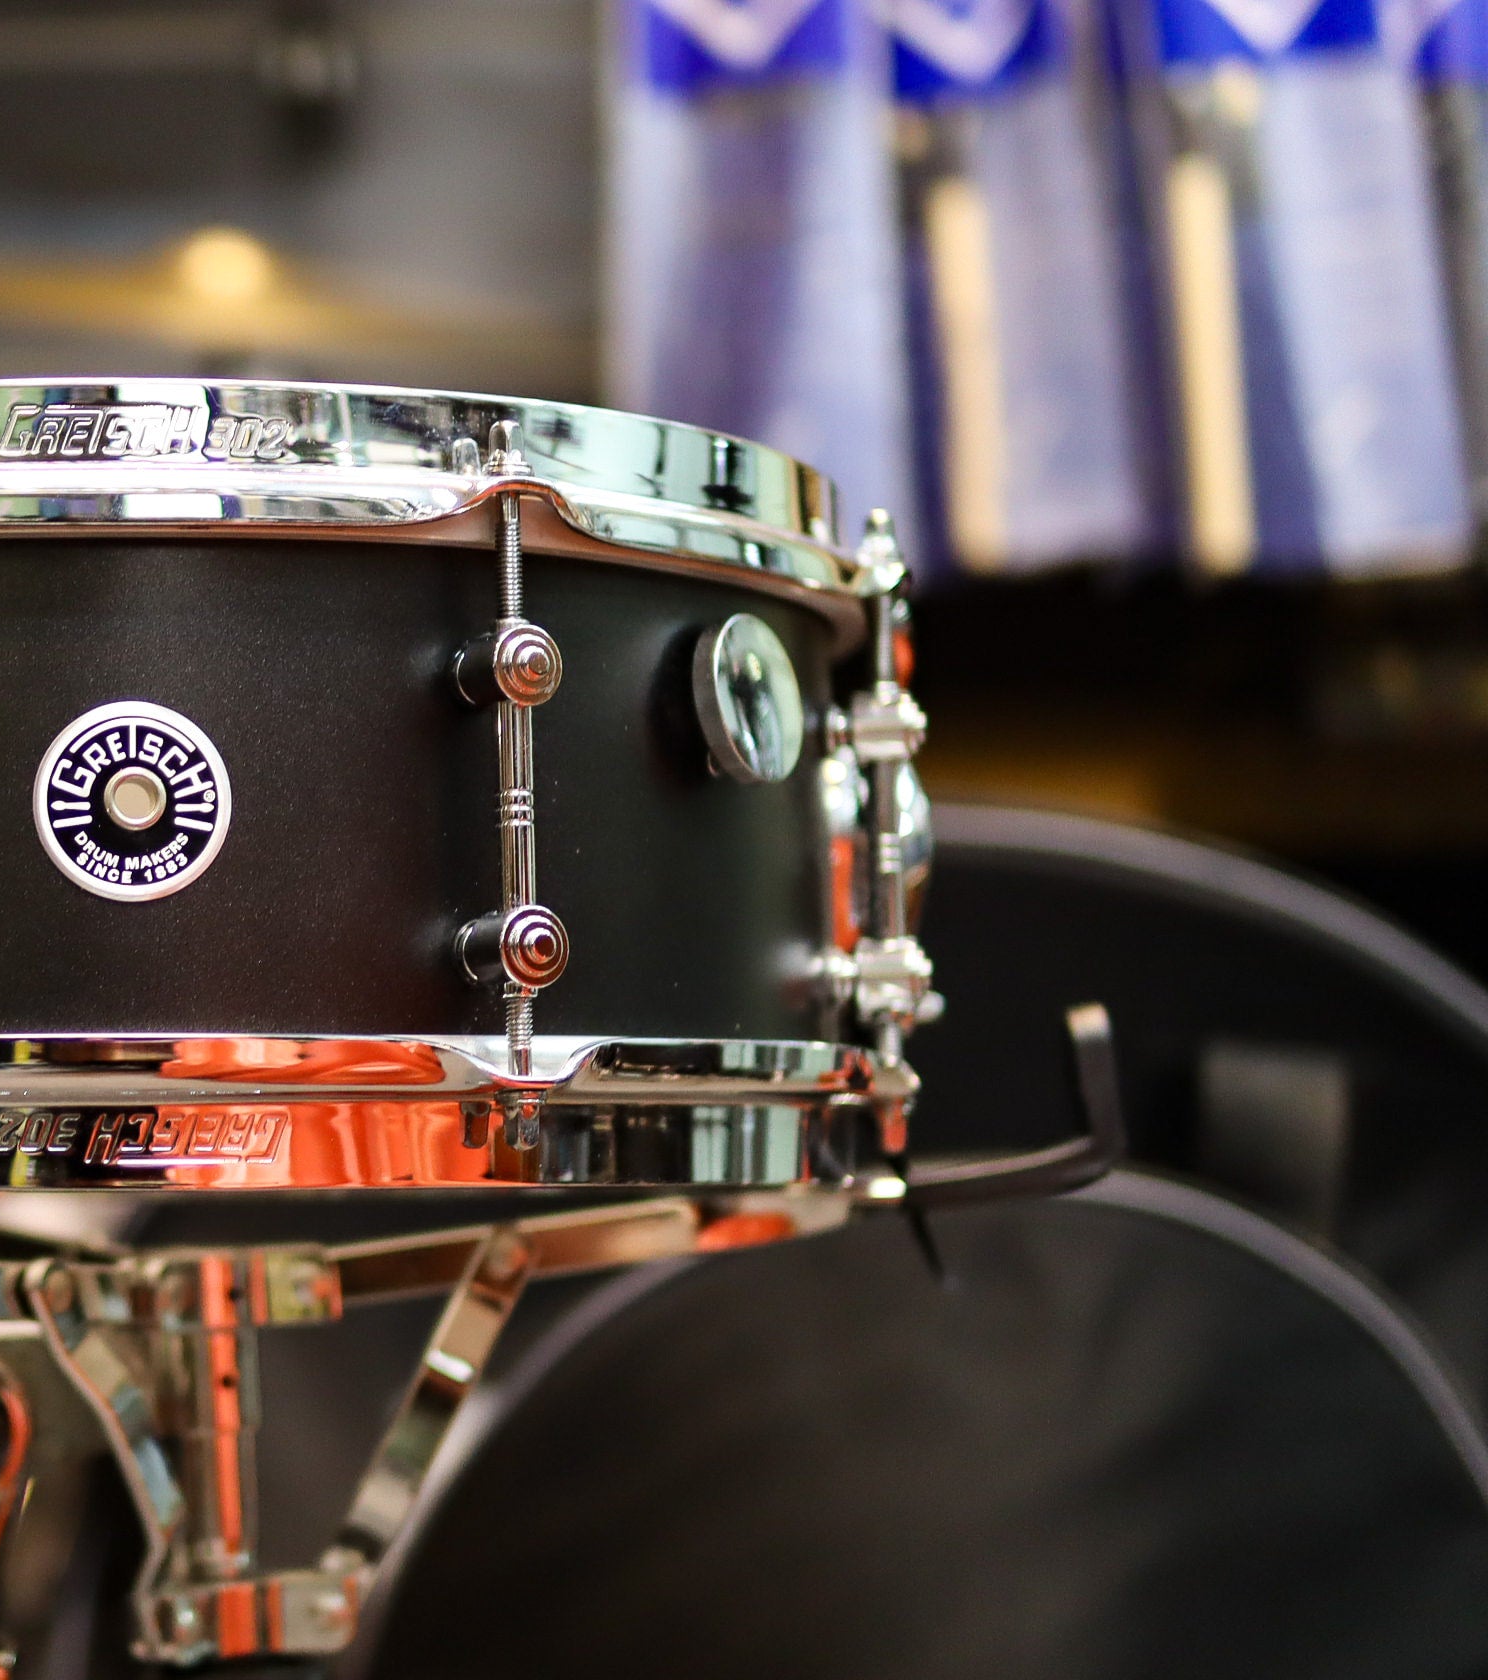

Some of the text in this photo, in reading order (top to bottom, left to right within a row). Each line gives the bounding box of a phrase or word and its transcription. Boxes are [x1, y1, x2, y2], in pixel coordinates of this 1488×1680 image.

[203, 415, 293, 460] 302
[74, 830, 189, 870] DRUM MAKERS
[76, 852, 188, 884] SINCE 1883
[83, 1110, 290, 1165] GRETSCH
